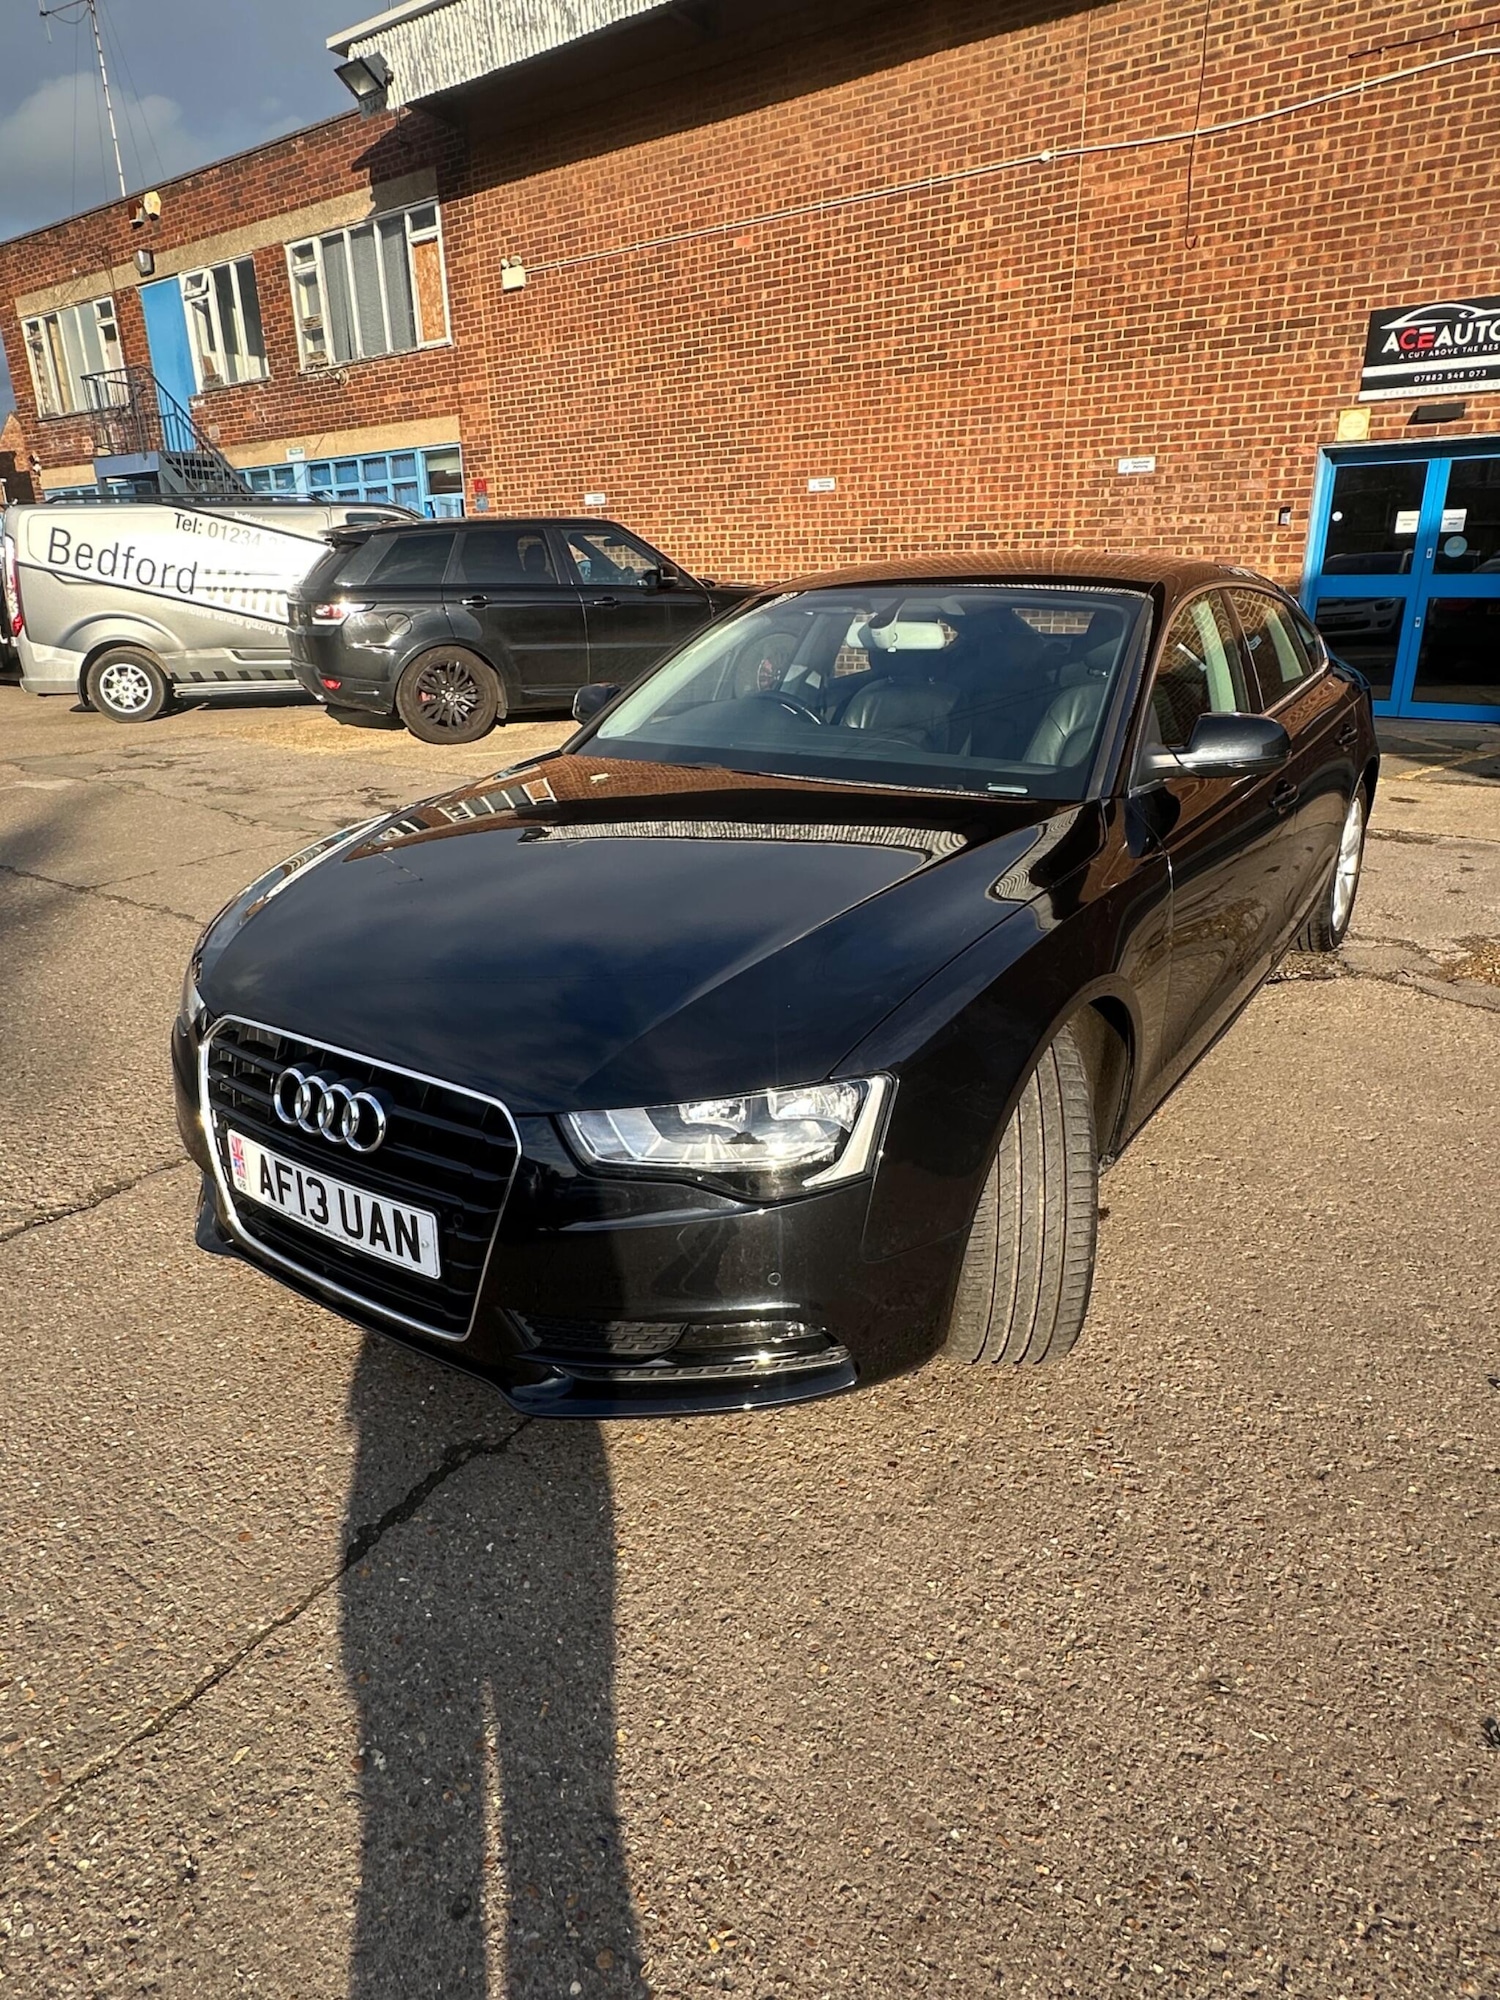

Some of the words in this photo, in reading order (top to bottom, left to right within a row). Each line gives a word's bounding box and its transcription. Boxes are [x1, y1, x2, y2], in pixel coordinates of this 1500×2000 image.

[1407, 350, 1426, 359] CUT
[1428, 347, 1459, 357] ABOVE
[1462, 345, 1479, 353] THE
[174, 511, 203, 535] Tel:
[48, 526, 198, 596] Bedford
[260, 1153, 329, 1226] AF13
[338, 1188, 422, 1264] UAN
